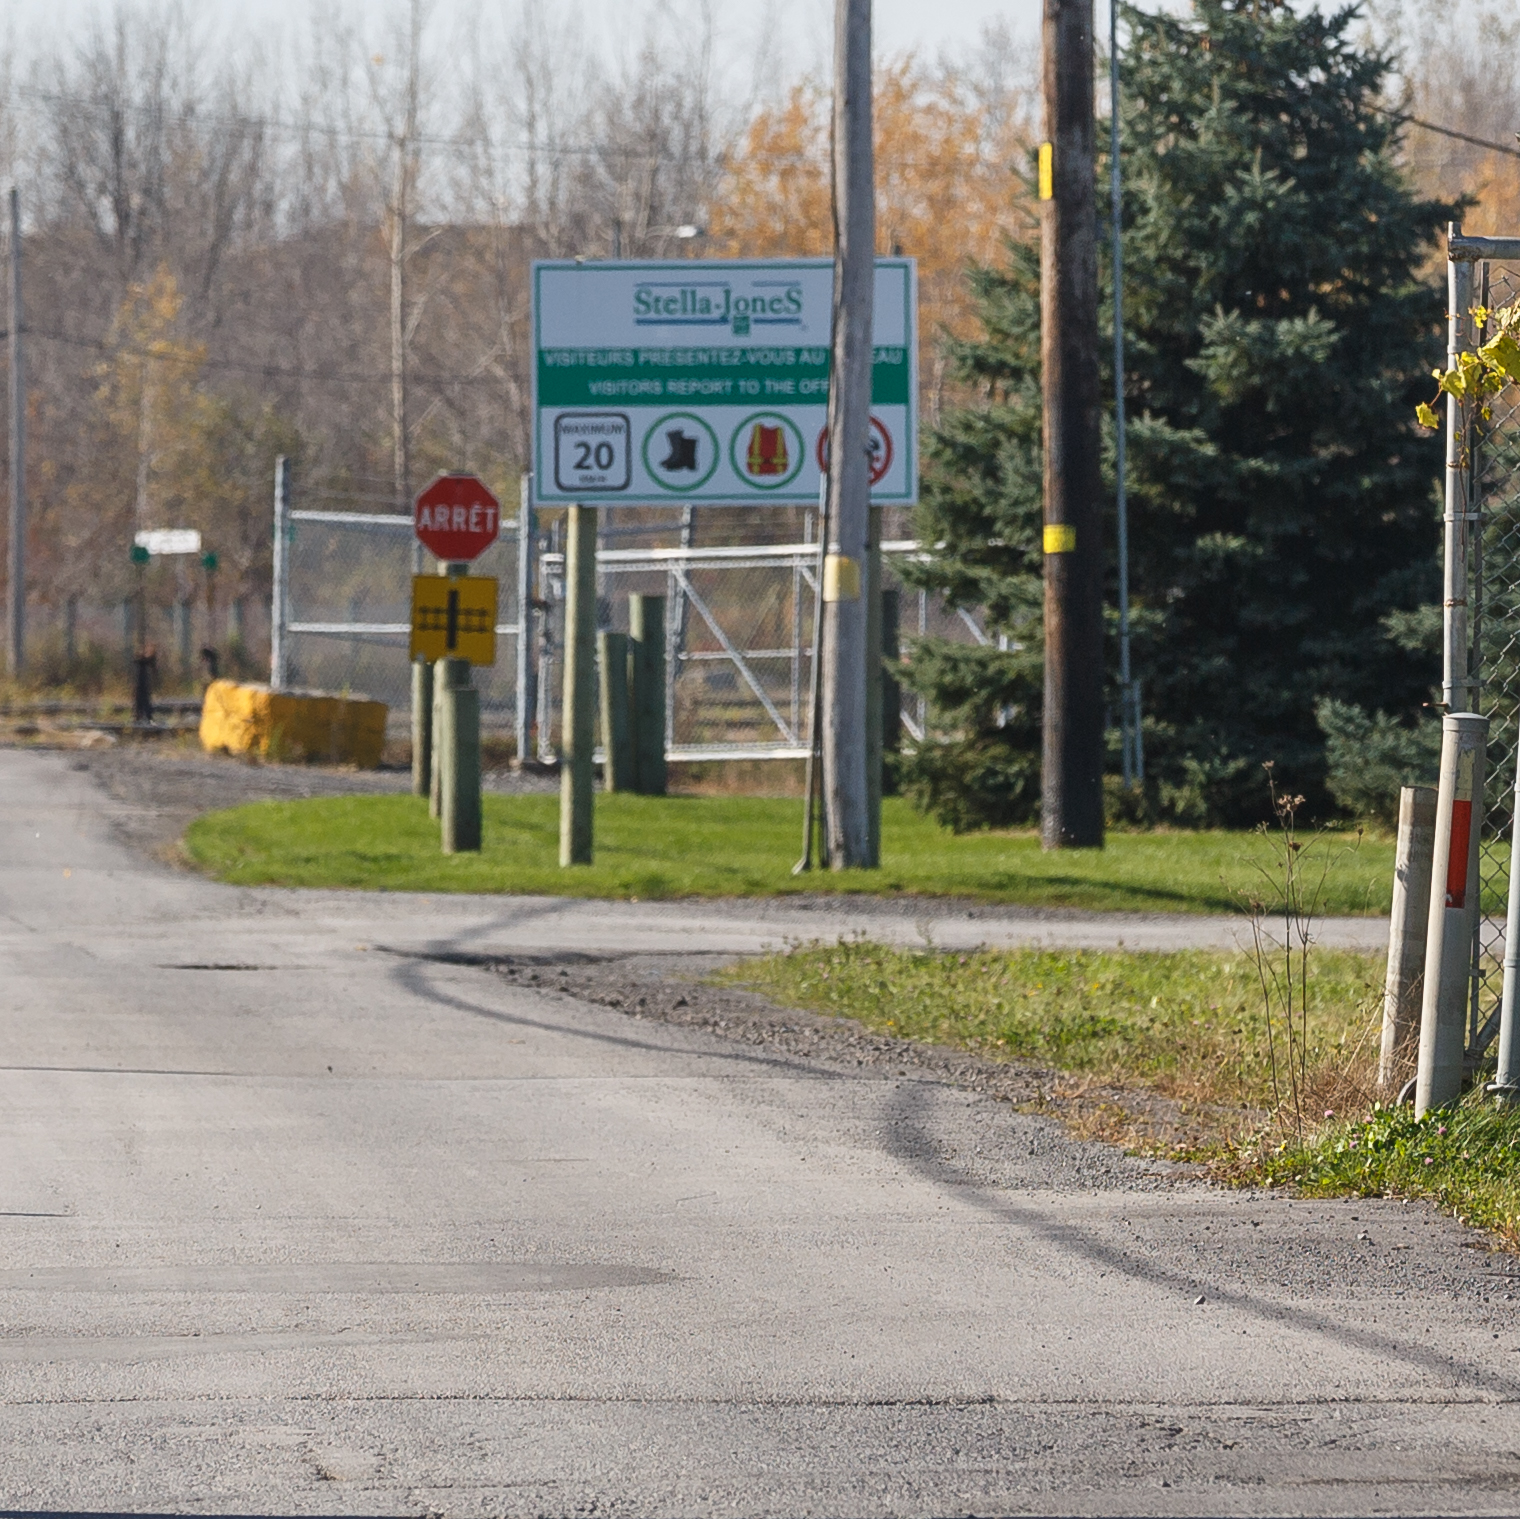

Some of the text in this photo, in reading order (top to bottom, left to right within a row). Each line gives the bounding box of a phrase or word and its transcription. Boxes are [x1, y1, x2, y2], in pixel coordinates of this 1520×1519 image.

[545, 350, 634, 367] VISITEURS
[799, 349, 826, 366] AU
[588, 380, 663, 395] VISITORS
[666, 379, 732, 395] REPORT
[738, 379, 760, 395] TO
[764, 379, 796, 395] THE
[572, 442, 614, 471] 20
[418, 501, 496, 533] ARRÊT
